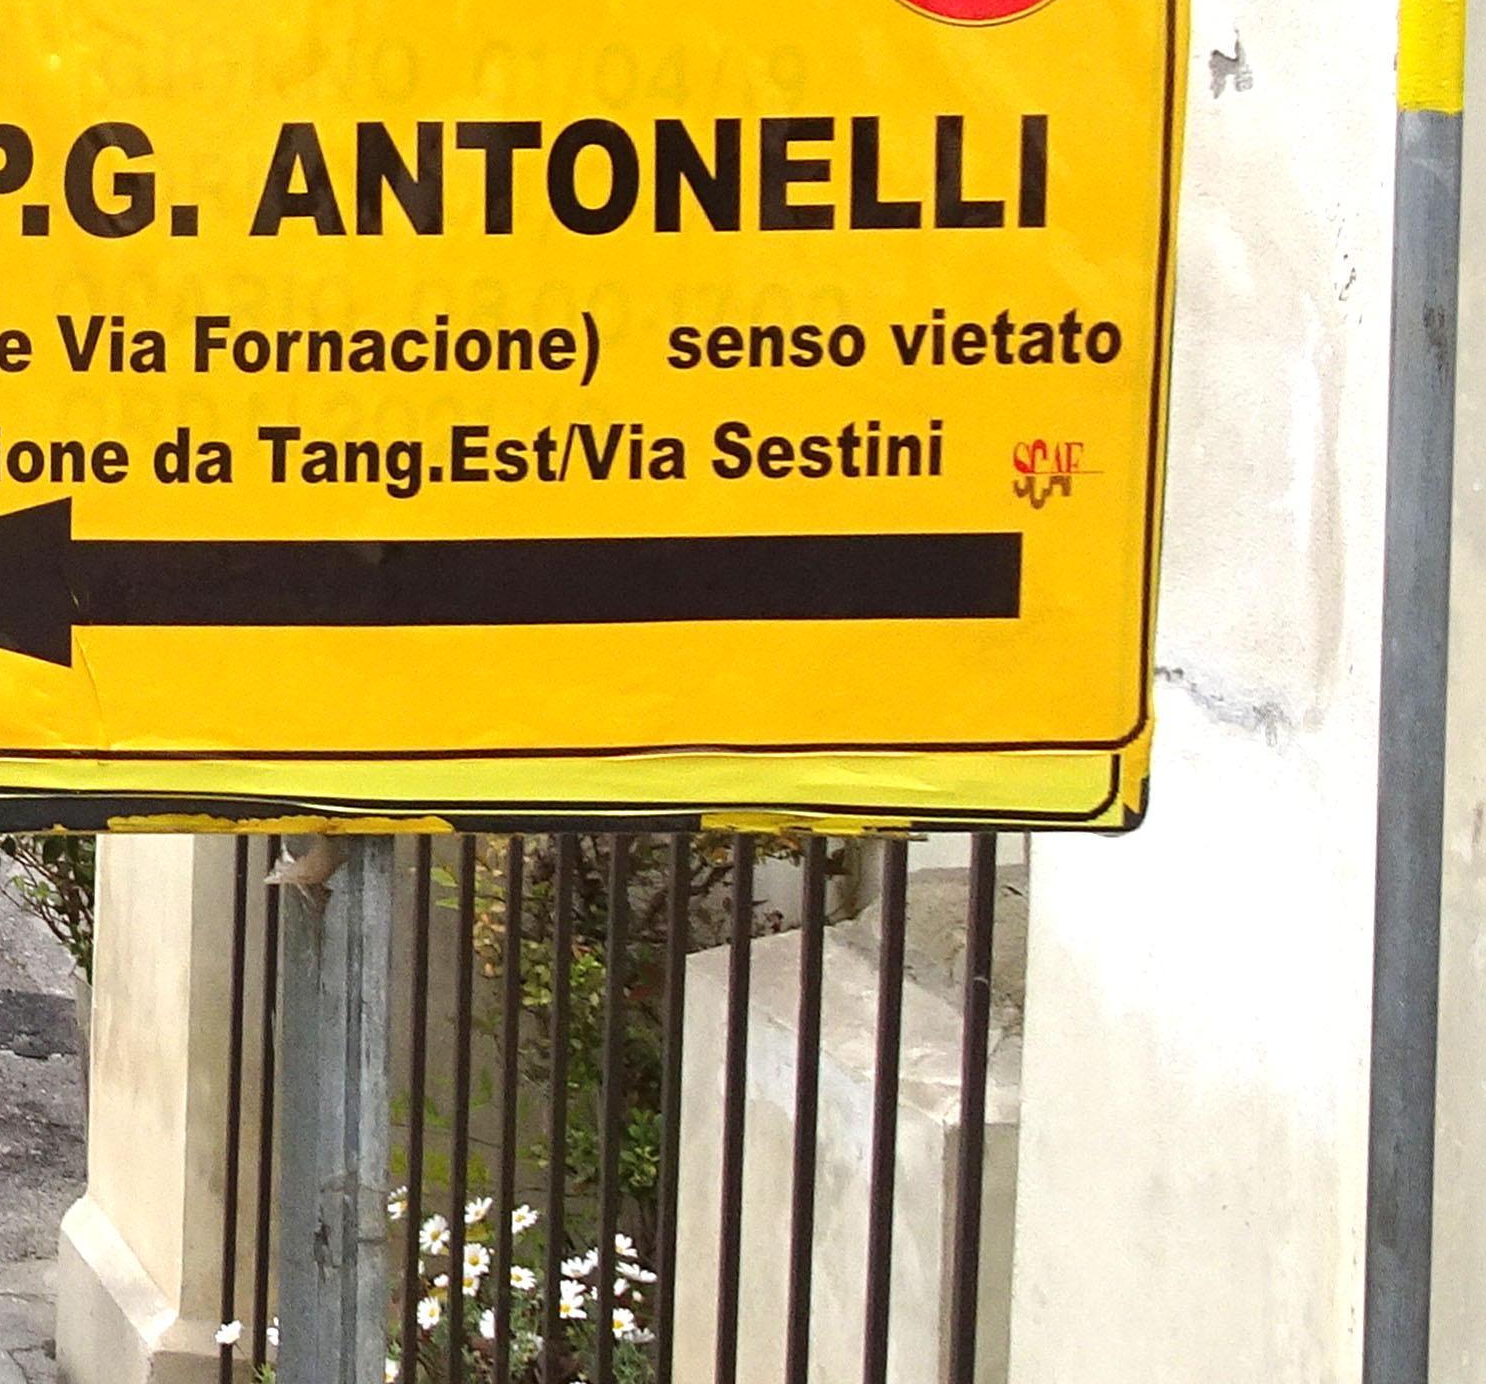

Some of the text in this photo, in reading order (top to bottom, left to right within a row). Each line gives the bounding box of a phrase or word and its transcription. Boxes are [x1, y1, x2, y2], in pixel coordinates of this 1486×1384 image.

[248, 114, 1048, 236] ANTONELLI
[56, 314, 167, 373] Via
[193, 310, 602, 387] Fornacione)
[667, 323, 866, 369] senso
[890, 307, 1123, 367] vietato
[152, 426, 234, 484] da
[257, 422, 687, 500] Tang.Est/Via
[711, 418, 943, 480] Sestini
